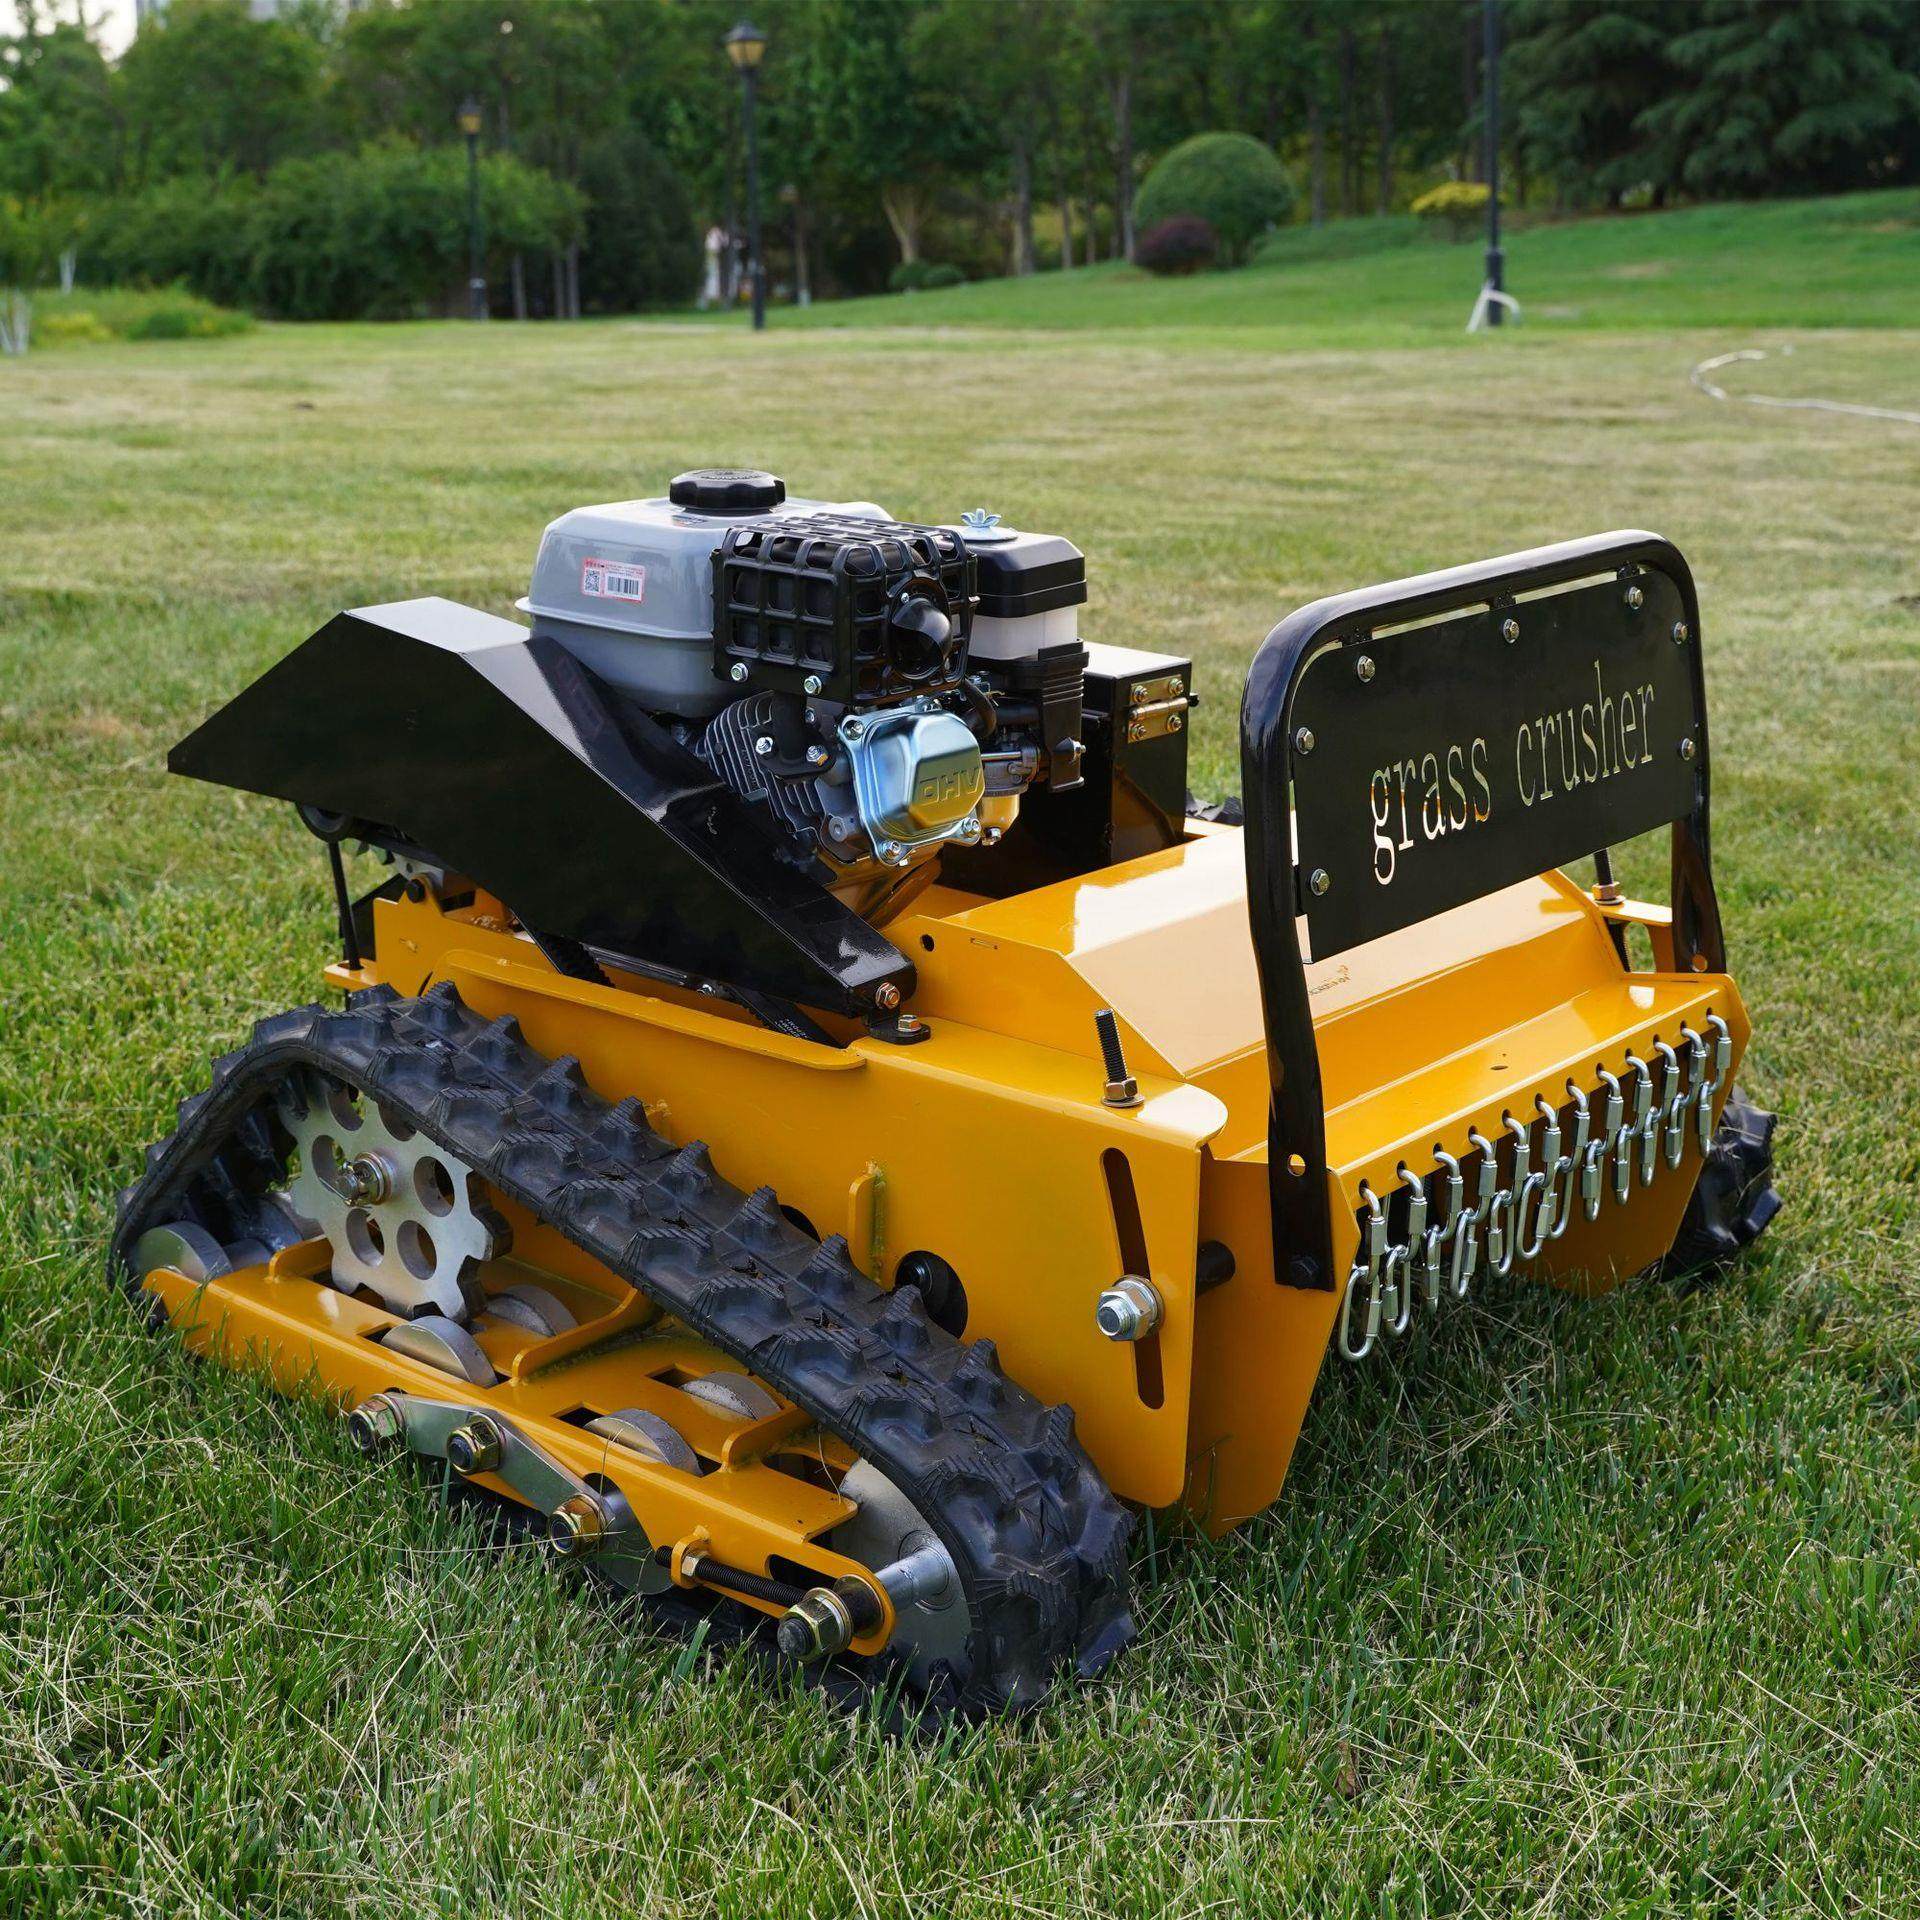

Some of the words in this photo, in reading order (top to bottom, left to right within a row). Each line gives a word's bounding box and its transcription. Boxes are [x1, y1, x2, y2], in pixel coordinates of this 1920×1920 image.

[919, 766, 981, 806] OHV
[1371, 738, 1491, 885] grass
[1517, 659, 1654, 806] crusher
